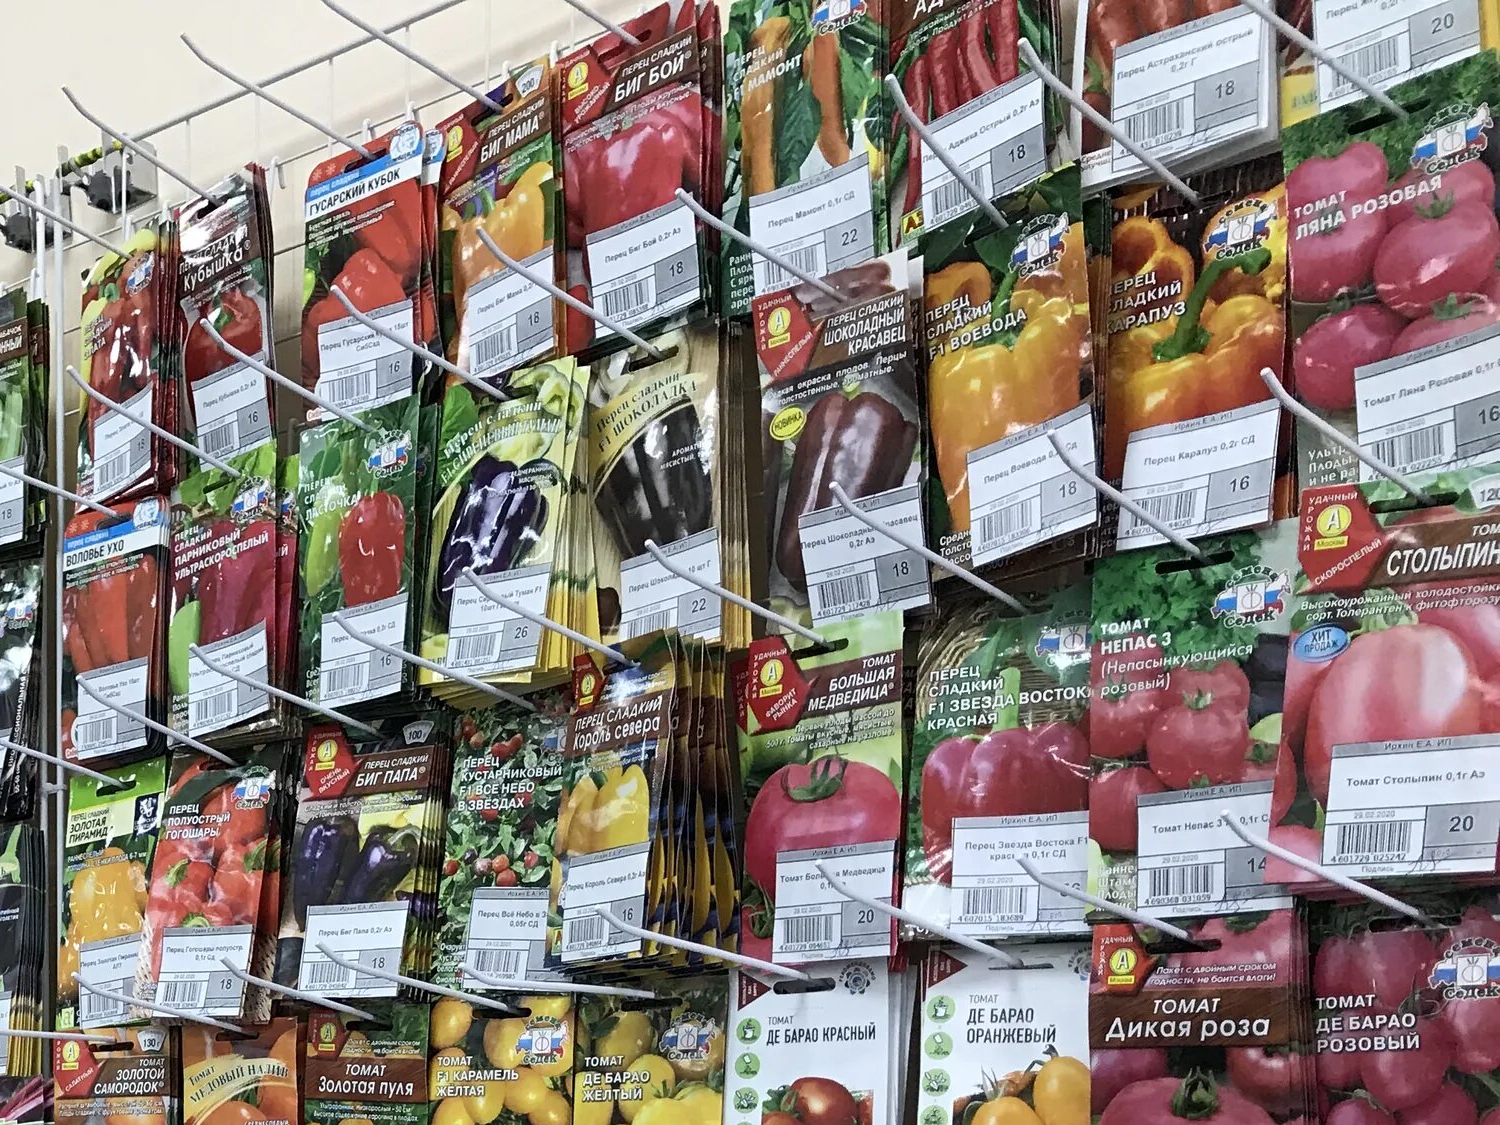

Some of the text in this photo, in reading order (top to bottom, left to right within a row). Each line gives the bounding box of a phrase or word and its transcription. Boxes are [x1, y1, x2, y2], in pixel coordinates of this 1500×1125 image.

[621, 36, 692, 78] ПЕРЕЦ СЛАДКИЙ
[749, 54, 802, 90] МАМОНТ
[1117, 67, 1144, 80] Перец
[614, 73, 642, 101] БИГ
[309, 169, 401, 216] ГУСАРСКИЙ КУБОК
[1296, 175, 1442, 240] ЛЯНА РОЗОВАЯ
[182, 247, 245, 292] Кубышка
[925, 295, 970, 322] ПЕРЕЦ
[823, 311, 905, 346] ШОКОЛАДНЫЙ
[927, 302, 992, 338] СЛАДКИЙ
[848, 327, 906, 355] КРАСАВЕЦ
[929, 309, 1026, 359] F1 ВОЕВОДА
[773, 410, 804, 432] НОВИНКА
[1309, 492, 1358, 504] УДАЧНЫЙ
[66, 540, 124, 567] ВОЛОВЬЕ УХО
[174, 532, 269, 579] УЛЬТРАСКОРОСПЕЛЫЙ
[175, 528, 241, 565] ПАРНИКОВЫЙ
[1314, 539, 1382, 586] СКОРОСПЕЛЫЙ
[1386, 540, 1500, 577] СТОЛЫПИН
[1101, 619, 1150, 636] ТОМАТ
[1310, 629, 1331, 645] ХИТ
[1101, 634, 1156, 654] НЕПАС
[1304, 638, 1339, 654] ПРОДАЖ
[1101, 645, 1253, 678] (Непасынкующийся
[829, 666, 895, 694] БОЛЬШАЯ
[931, 666, 980, 682] ПЕРЕЦ
[929, 677, 1004, 697] СЛАДКИЙ
[1101, 674, 1171, 695] розовый)
[929, 693, 1014, 715] F1 ЗВЕЗДА
[928, 712, 997, 729] КРАСНАЯ
[572, 717, 660, 751] Король севера
[356, 768, 418, 787] БИГ ПАПА
[1346, 776, 1378, 787] Томат
[1384, 774, 1442, 786] Столыпин
[167, 812, 230, 826] ПОЛУОСТРЫЙ
[1449, 816, 1474, 832] 20
[166, 827, 219, 839] ГОГОШАРЫ
[371, 956, 385, 968] 18
[967, 1008, 1034, 1025] ДЕ БАРАО
[1316, 1014, 1415, 1034] ДЕ БАРАО
[767, 1024, 876, 1045] ДЕ БАРАО КРАСНЫЙ
[966, 1025, 1057, 1044] ОРАНЖЕВЫЙ
[1105, 1018, 1270, 1041] Дикая роза
[1317, 1034, 1420, 1052] РОЗОВЫЙ
[116, 1067, 165, 1081] ЗОЛОТОЙ
[437, 1069, 519, 1082] F1 КАРАМЕЛЬ
[583, 1070, 649, 1086] ДЕ БАРАО
[318, 1077, 413, 1097] Золотая пуля
[437, 1083, 484, 1097] ЖЁЛТАЯ
[582, 1087, 643, 1101] ЖЁЛТЫЙ
